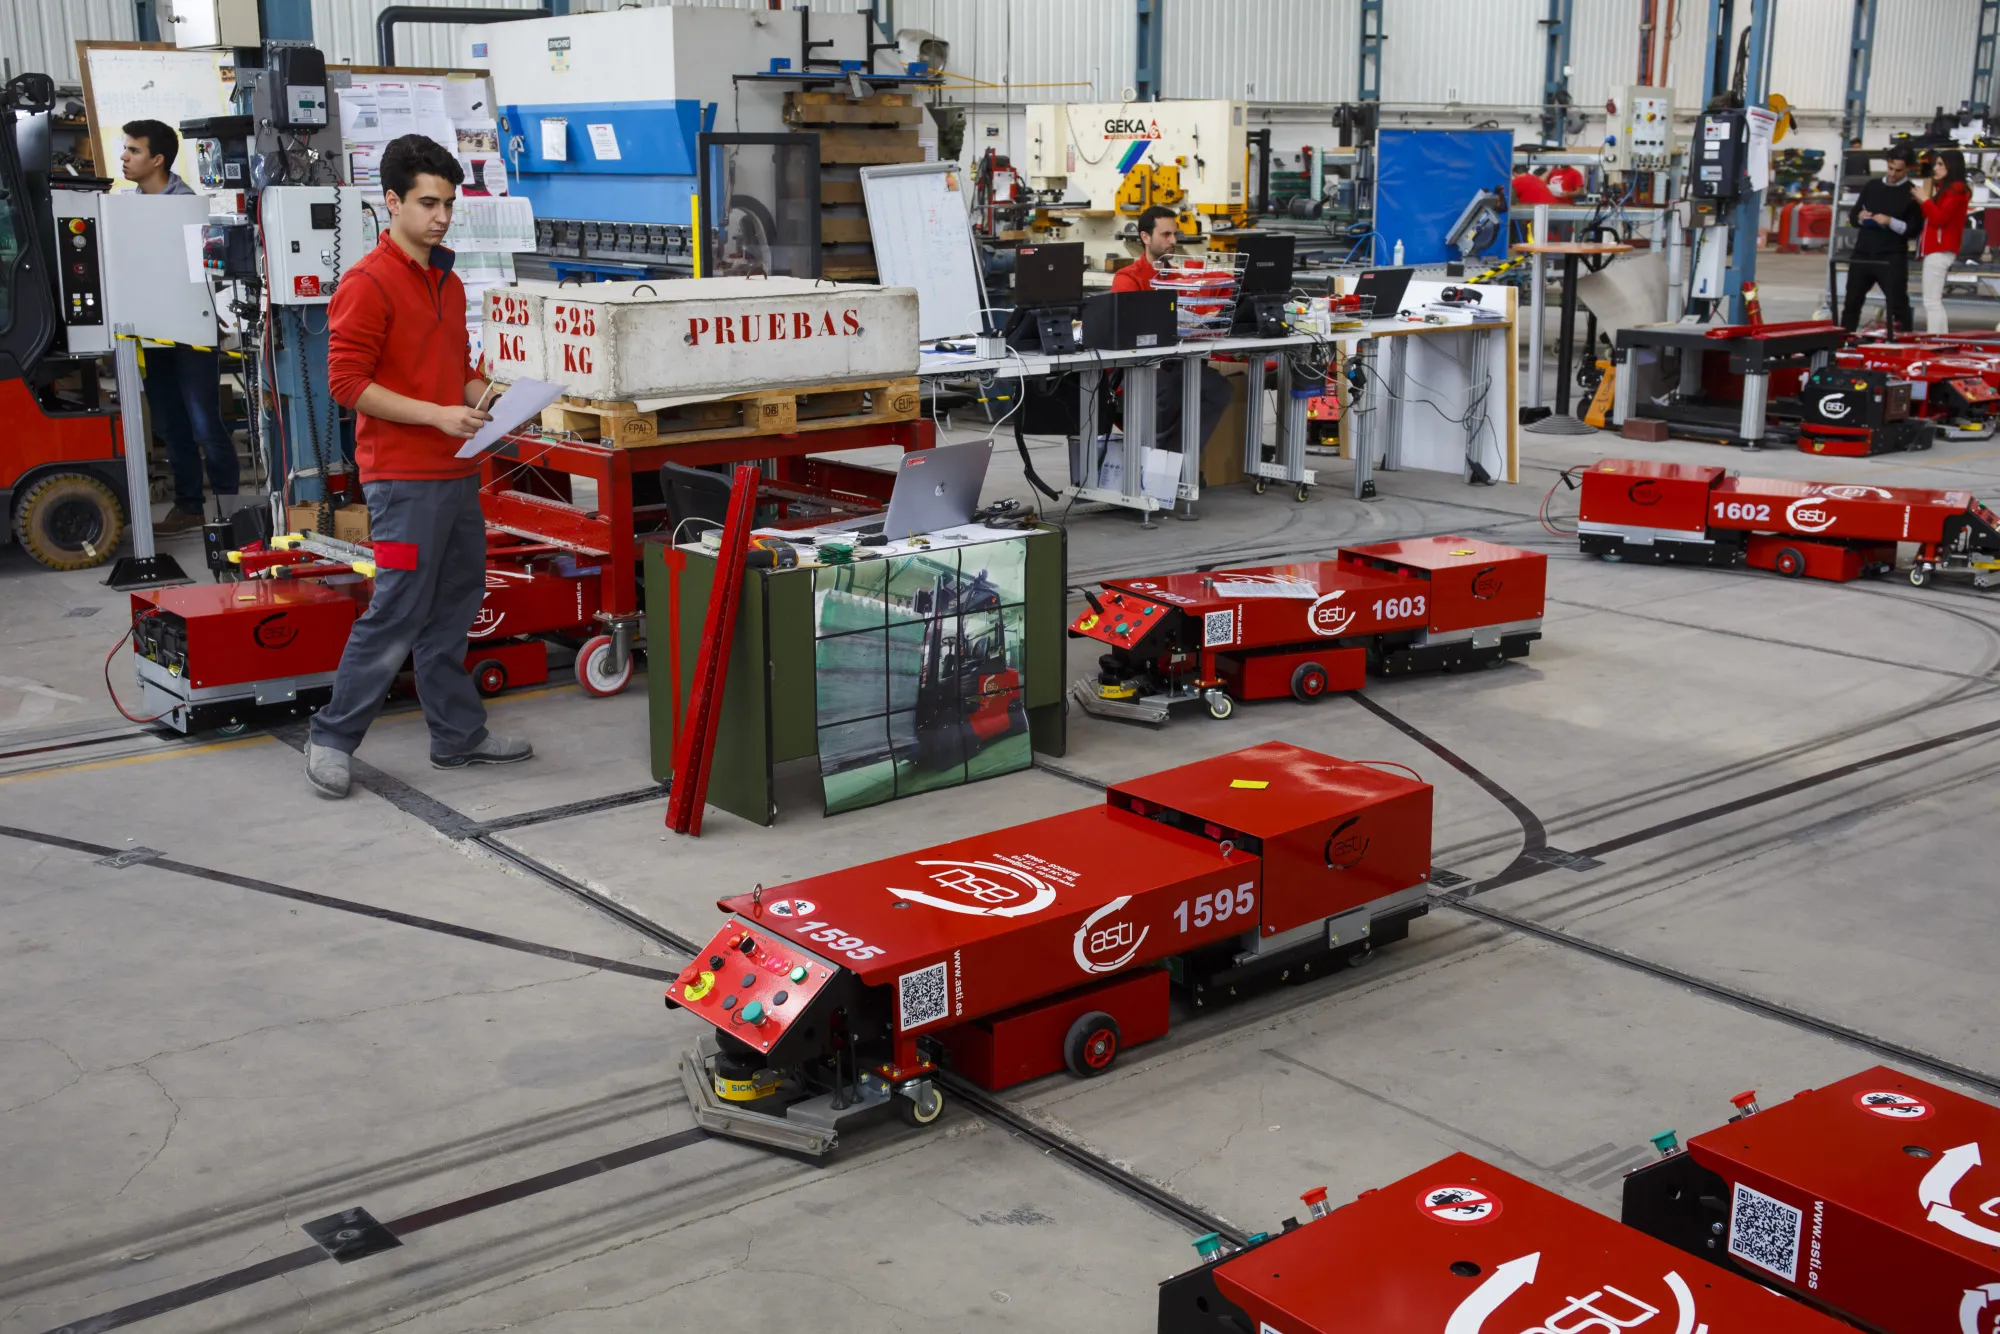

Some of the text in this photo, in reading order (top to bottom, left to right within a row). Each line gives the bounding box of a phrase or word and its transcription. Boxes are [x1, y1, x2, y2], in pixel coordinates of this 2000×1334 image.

[1104, 119, 1146, 133] GEKA
[491, 296, 529, 326] 325
[555, 306, 596, 337] 325
[688, 309, 860, 346] PRUEBAS
[499, 332, 526, 362] KG
[563, 343, 593, 374] KG
[1713, 501, 1771, 521] 1602
[1796, 509, 1827, 523] asti
[473, 607, 494, 624] sti
[1317, 606, 1346, 623] asti
[1371, 595, 1426, 621] 1603
[1334, 834, 1363, 857] asti
[929, 868, 1020, 903] asti
[1173, 881, 1255, 933] 1595
[795, 920, 887, 961] 1595
[1091, 921, 1133, 954] asti
[953, 949, 963, 1017] www.asti.es
[731, 1084, 753, 1092] SICK
[1808, 1200, 1824, 1290] www.asti.es
